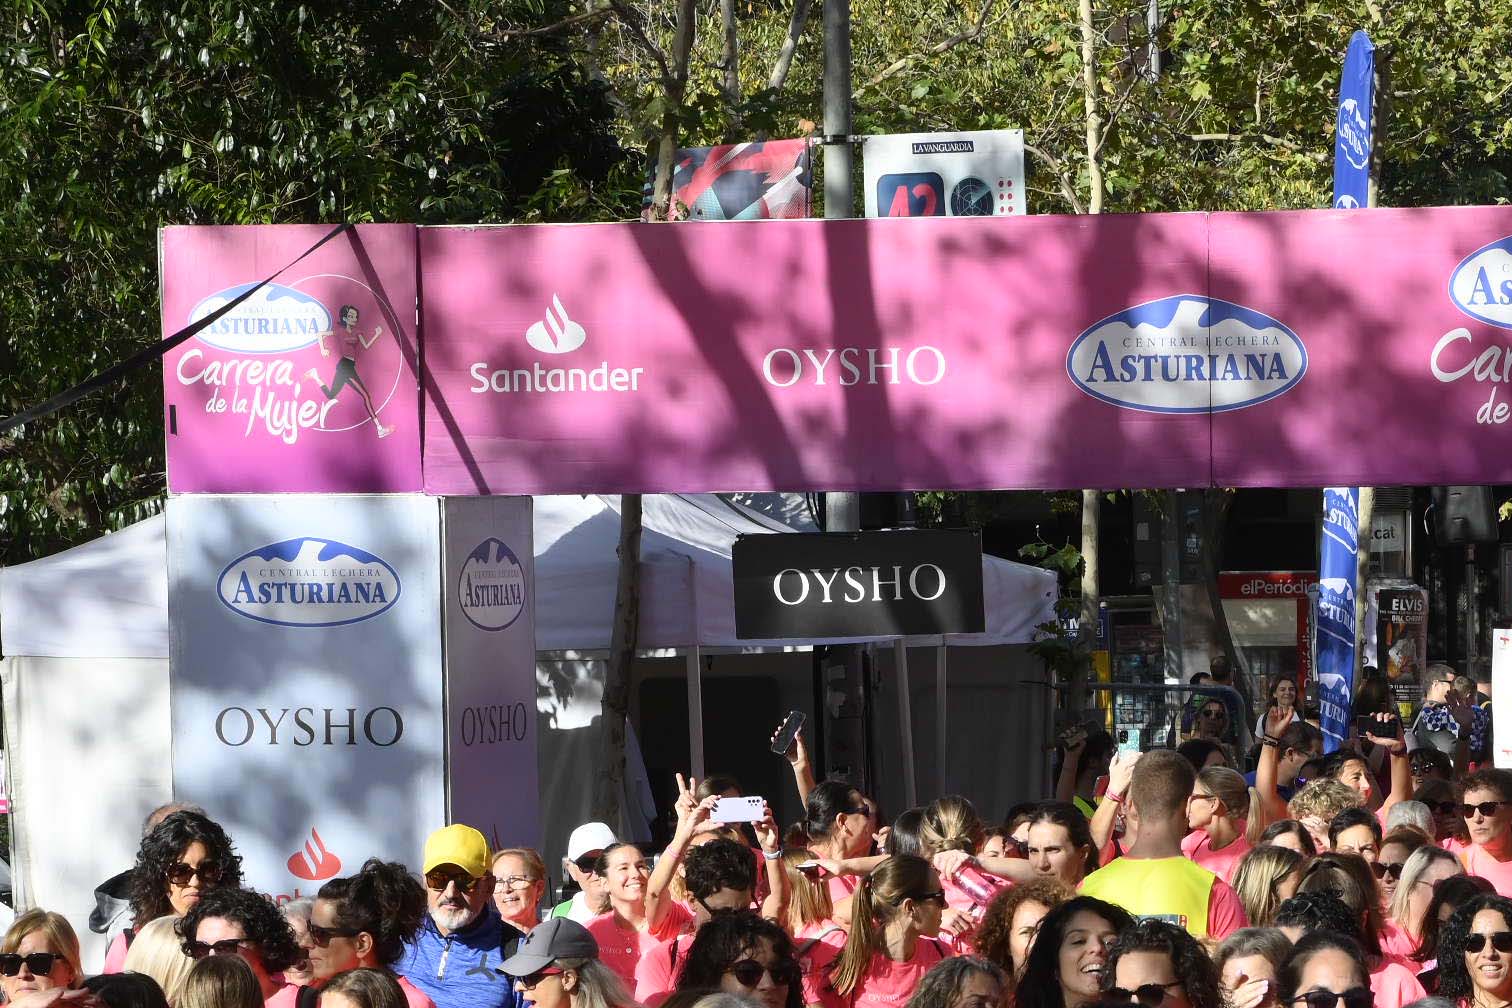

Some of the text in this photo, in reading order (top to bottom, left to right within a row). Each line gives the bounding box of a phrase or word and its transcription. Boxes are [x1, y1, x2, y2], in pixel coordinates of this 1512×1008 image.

[1122, 335, 1280, 348] CENTRAL LECHERA
[176, 349, 294, 385] Carrera
[470, 362, 644, 393] Santander
[763, 346, 946, 389] OYSHO
[1086, 340, 1289, 382] ASTURIANA
[206, 384, 338, 444] de la Mujer
[1477, 386, 1510, 425] de
[231, 570, 388, 604] ASTURIANA
[259, 568, 381, 577] CENTRAL LECHERA
[773, 563, 946, 605] OYSHO
[464, 577, 522, 608] ASTURIANA
[1392, 598, 1423, 611] ELVIS
[215, 706, 404, 746] OYSHO
[461, 702, 527, 746] OYSHO
